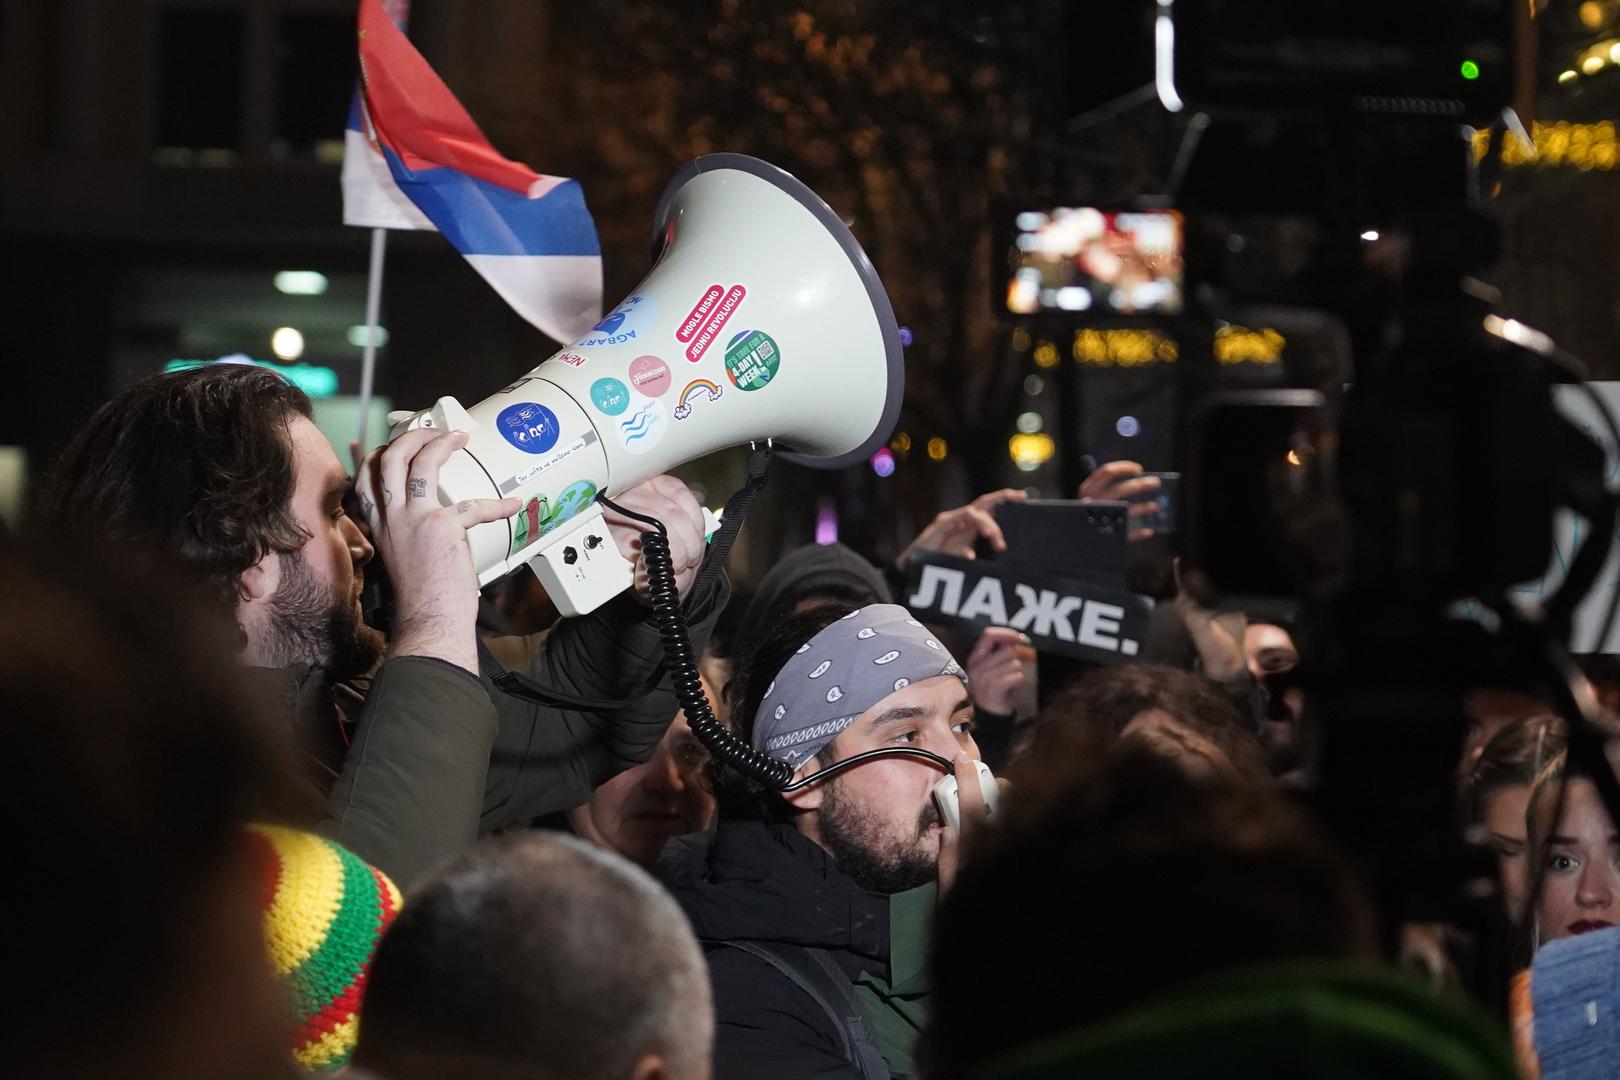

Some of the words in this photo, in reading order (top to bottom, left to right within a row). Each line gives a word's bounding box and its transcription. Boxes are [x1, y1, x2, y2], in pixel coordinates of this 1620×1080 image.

[681, 312, 703, 338] MOGLE
[699, 290, 719, 313] BISMO
[690, 333, 711, 358] JEDNU
[707, 289, 742, 335] REVOLUCIJU
[732, 354, 753, 376] 4-DAY
[909, 565, 1138, 656] ЛАЖЕ.
